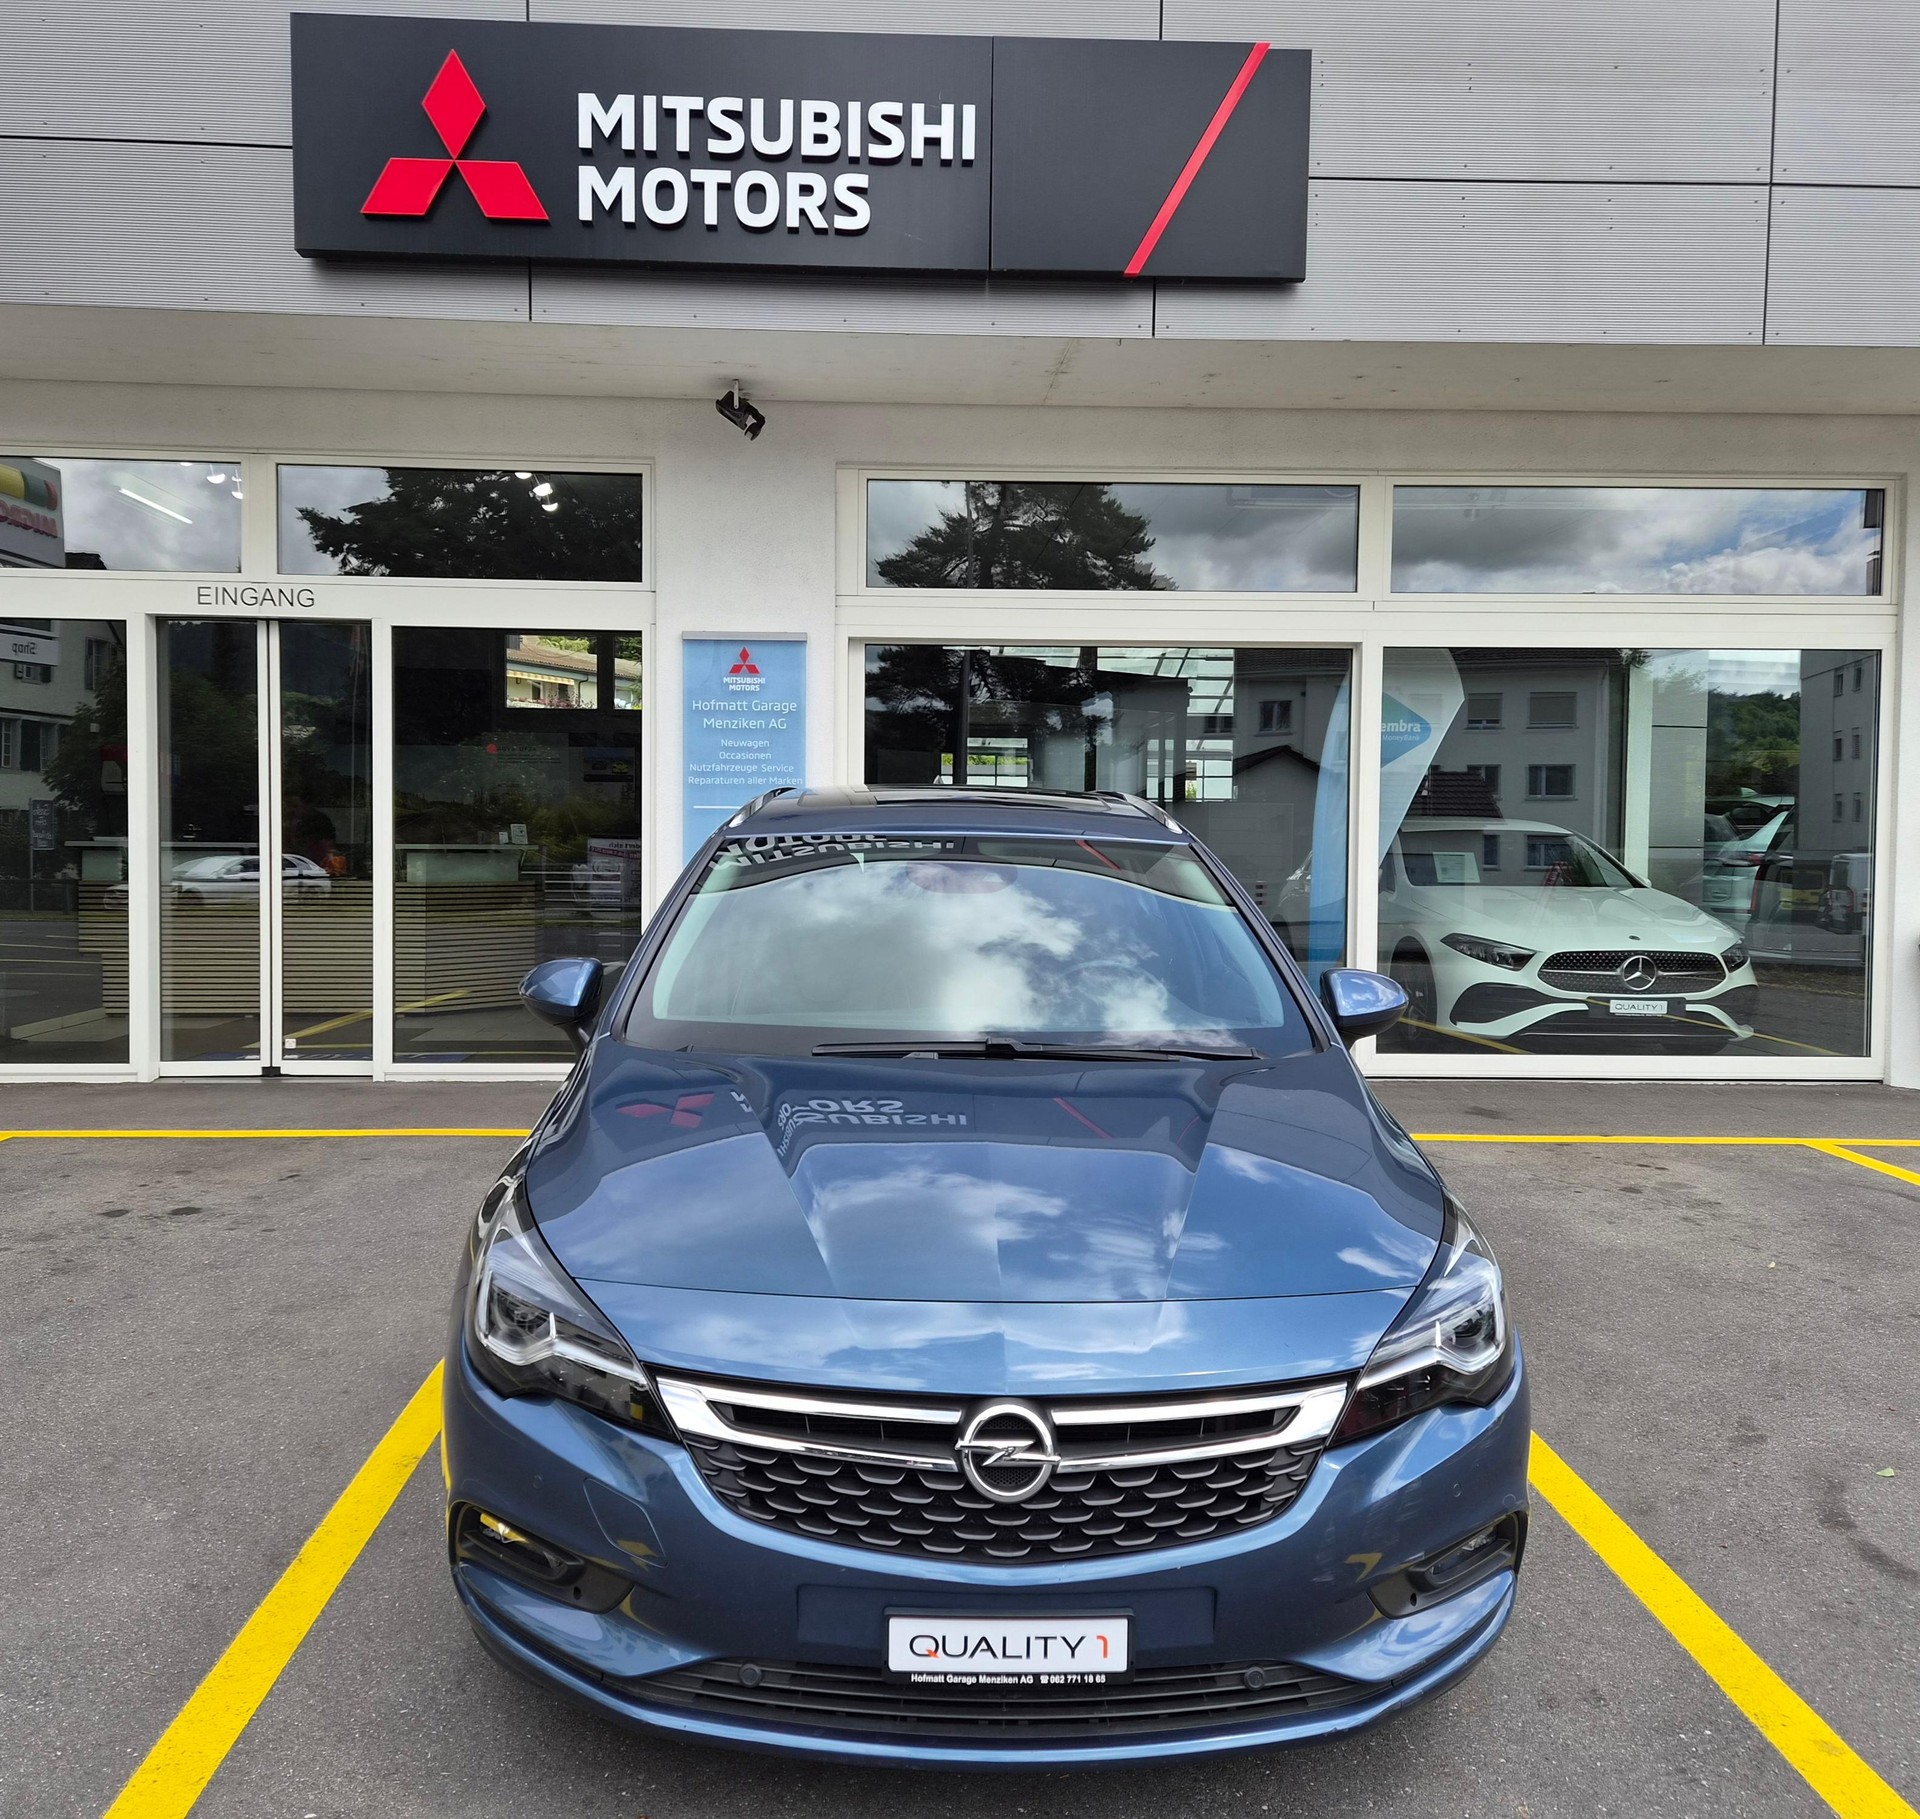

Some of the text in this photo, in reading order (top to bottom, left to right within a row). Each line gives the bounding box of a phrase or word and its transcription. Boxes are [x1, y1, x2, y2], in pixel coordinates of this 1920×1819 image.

[577, 92, 977, 162] MITSUBISHI
[577, 165, 871, 231] MOTORS
[197, 586, 315, 608] EINGANG
[723, 676, 765, 684] MITSUBISHI
[692, 699, 797, 713] Hofmatt Garage
[703, 718, 787, 729] Menziken AG
[721, 740, 770, 749] Neuwagen
[719, 752, 772, 760] Occasionen
[689, 764, 794, 773] Nutzfahrzeuge Service
[688, 776, 803, 785] Reparaturen aller Marken
[1614, 1003, 1658, 1011] QUALITY
[909, 1634, 1109, 1659] QUALITY 1
[911, 1673, 945, 1683] Hofmatt
[946, 1674, 977, 1685] Garage
[979, 1674, 1018, 1684] Menziken
[1020, 1675, 1034, 1684] AG
[1067, 1675, 1081, 1683] 771
